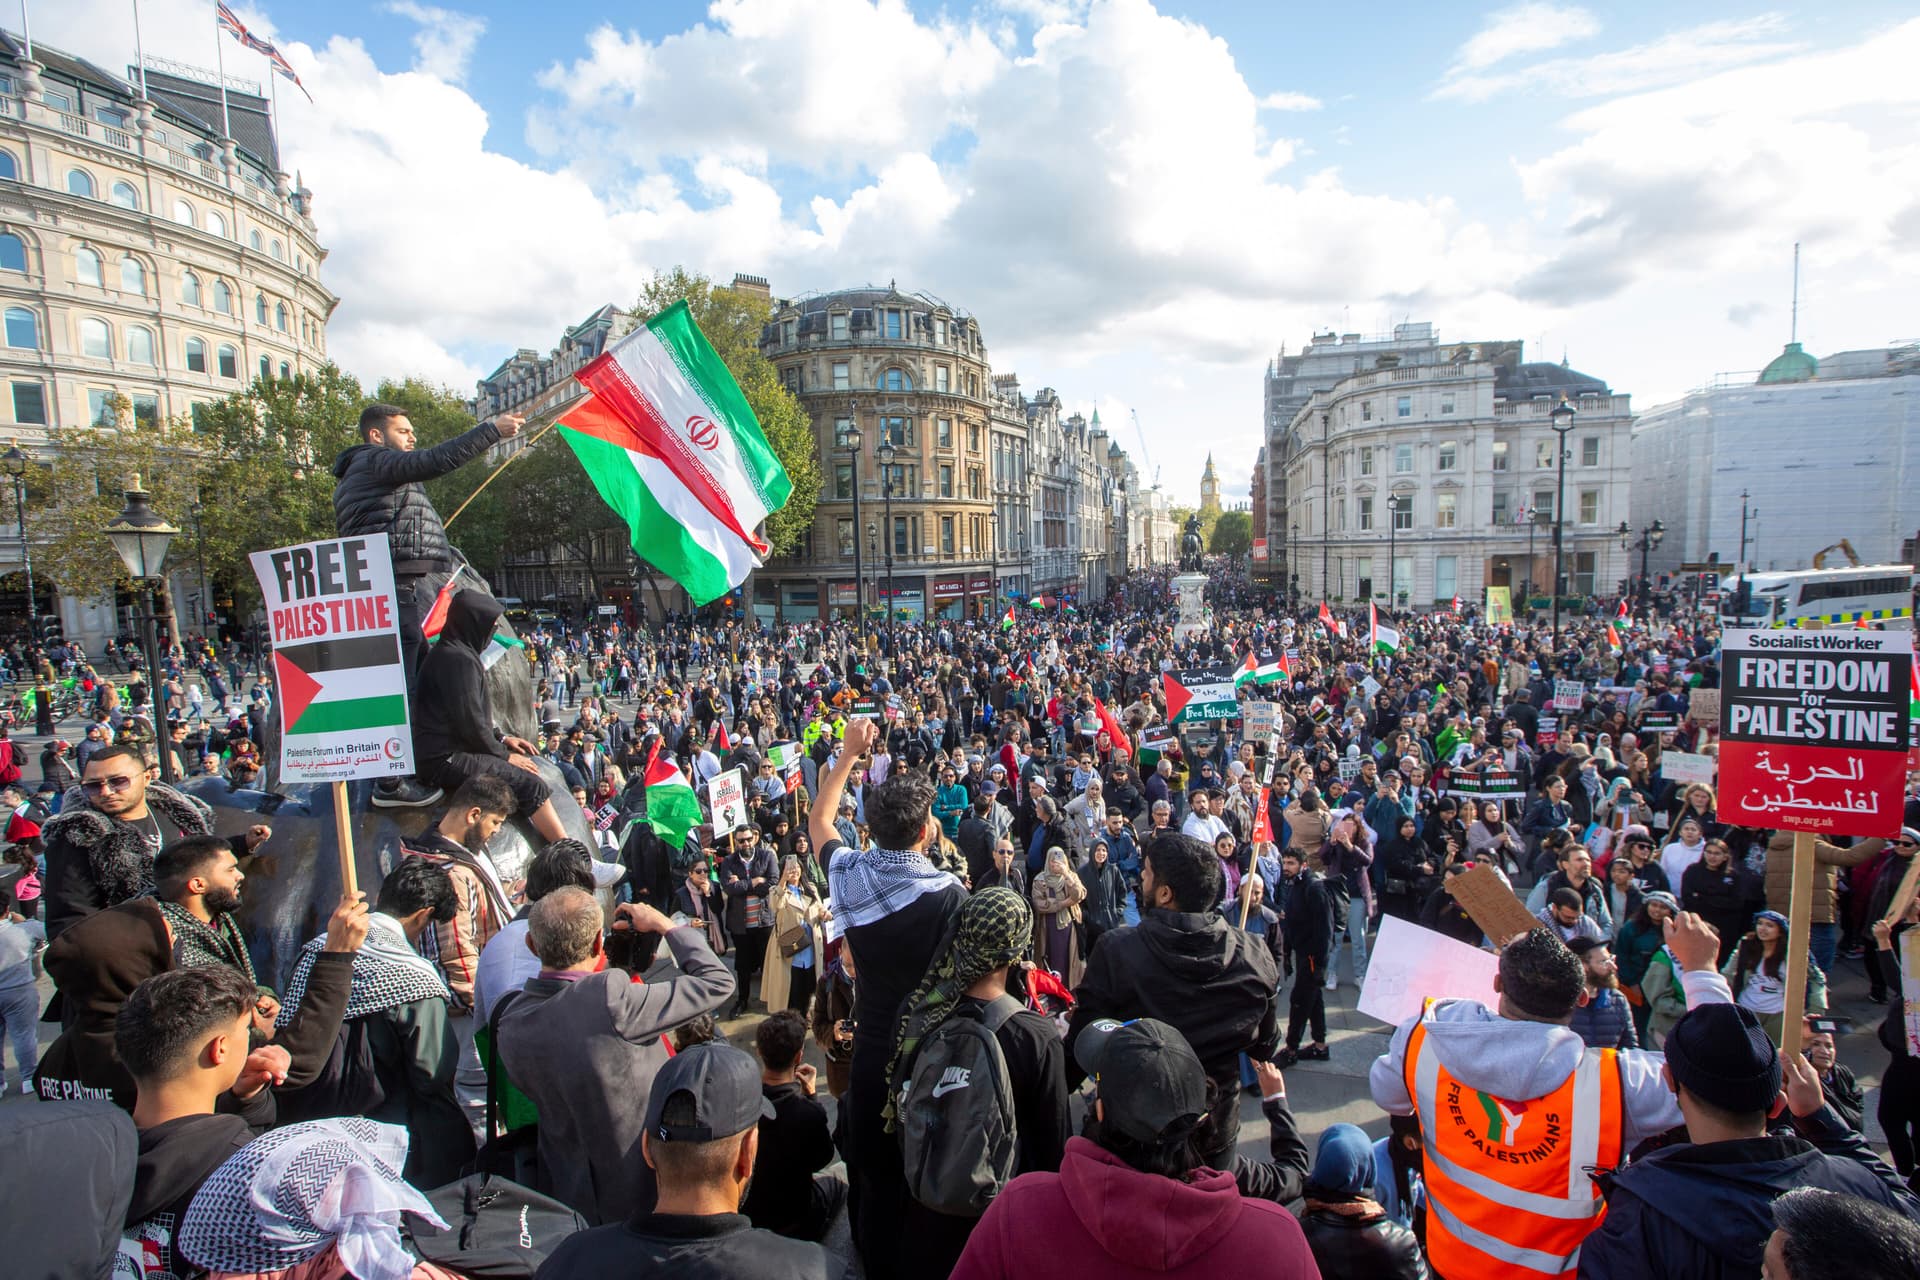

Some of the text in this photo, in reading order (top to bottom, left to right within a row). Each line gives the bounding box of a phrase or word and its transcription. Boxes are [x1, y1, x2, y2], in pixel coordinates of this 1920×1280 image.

[271, 539, 372, 603] FREE
[273, 595, 392, 642] PALESTINE
[1749, 634, 1883, 650] Socialist Worker
[1181, 672, 1203, 685] From
[1738, 657, 1890, 693] FREEDOM
[1800, 690, 1826, 706] for
[1185, 706, 1203, 719] Free
[1730, 703, 1898, 744] PALESTINE
[313, 746, 333, 756] Forum
[335, 745, 344, 755] in
[347, 741, 380, 754] Britain
[389, 761, 405, 770] PFB
[1754, 750, 1864, 784] الحرية
[719, 778, 731, 788] END
[716, 786, 736, 799] ISRAELI
[1740, 783, 1879, 814] لفلسطين
[713, 794, 741, 809] APARTHEID
[1782, 814, 1834, 827] swp.org.uk
[940, 1066, 971, 1085] NIKE
[40, 1076, 62, 1100] FREE
[1447, 1082, 1561, 1165] FREE PALESTINIANS
